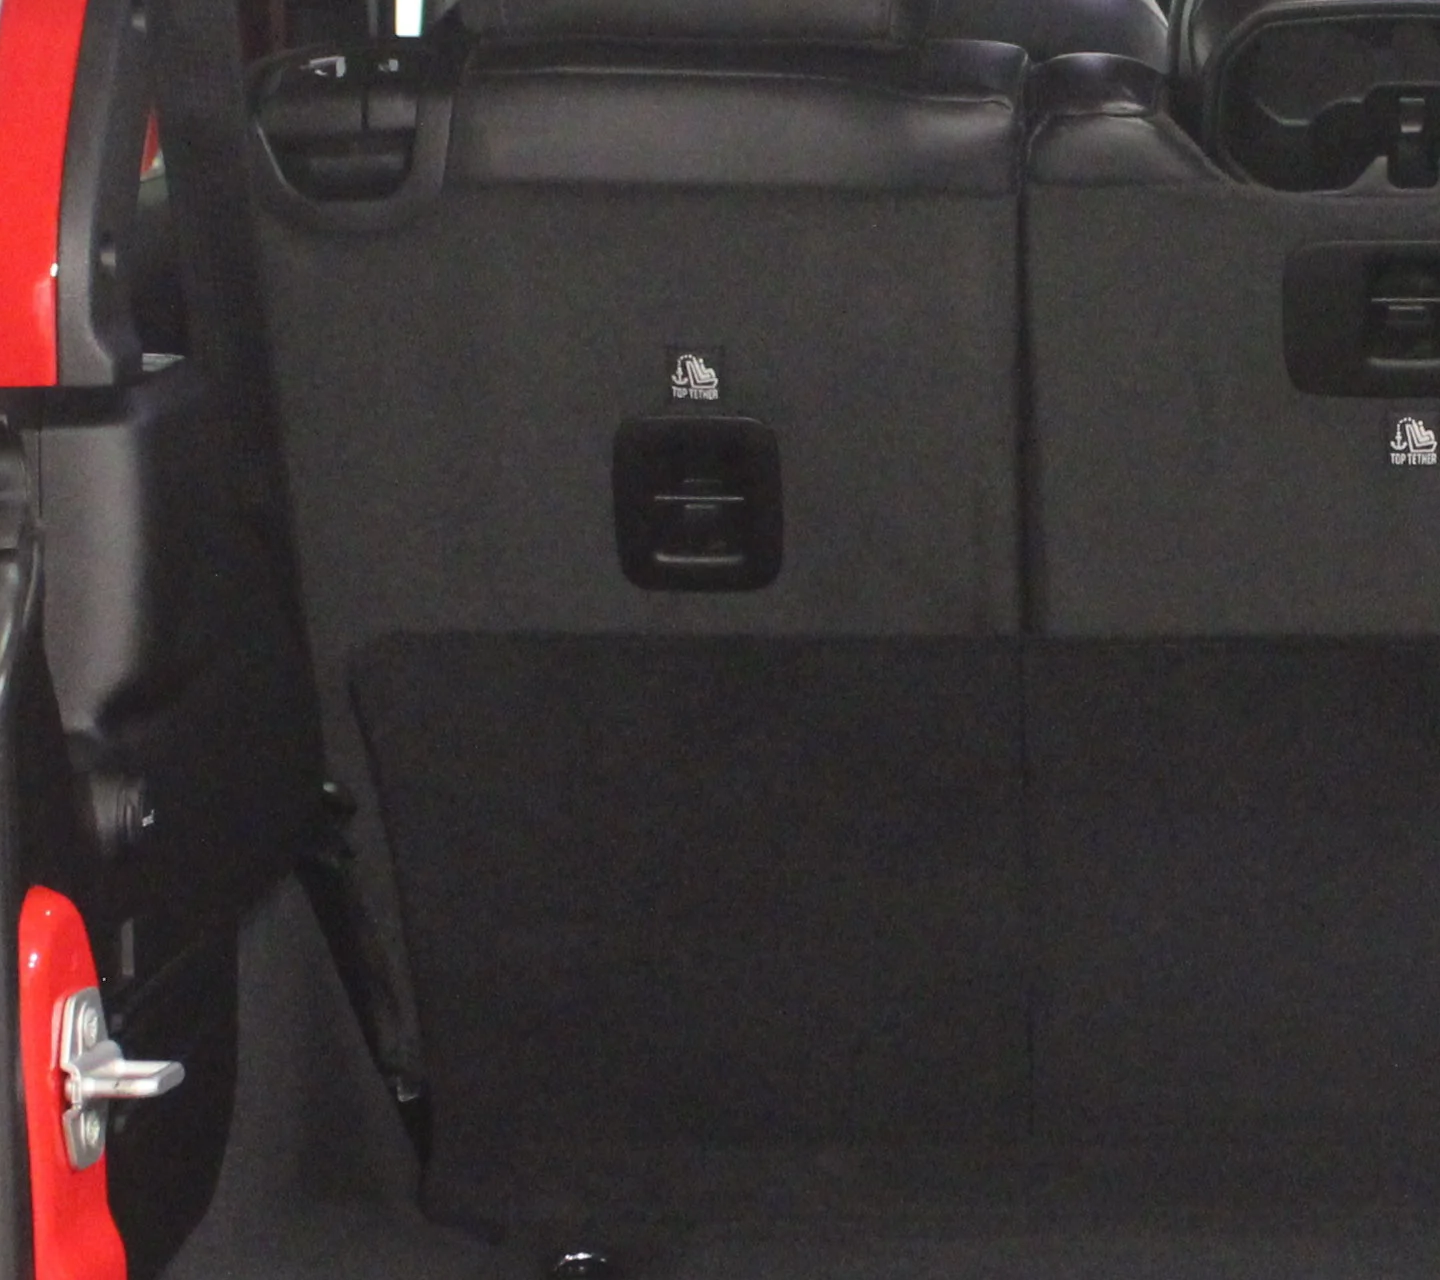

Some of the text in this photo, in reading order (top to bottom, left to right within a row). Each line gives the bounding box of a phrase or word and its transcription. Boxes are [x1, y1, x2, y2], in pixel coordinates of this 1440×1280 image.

[672, 385, 688, 399] TOP
[1390, 452, 1437, 466] TOP TETHER
